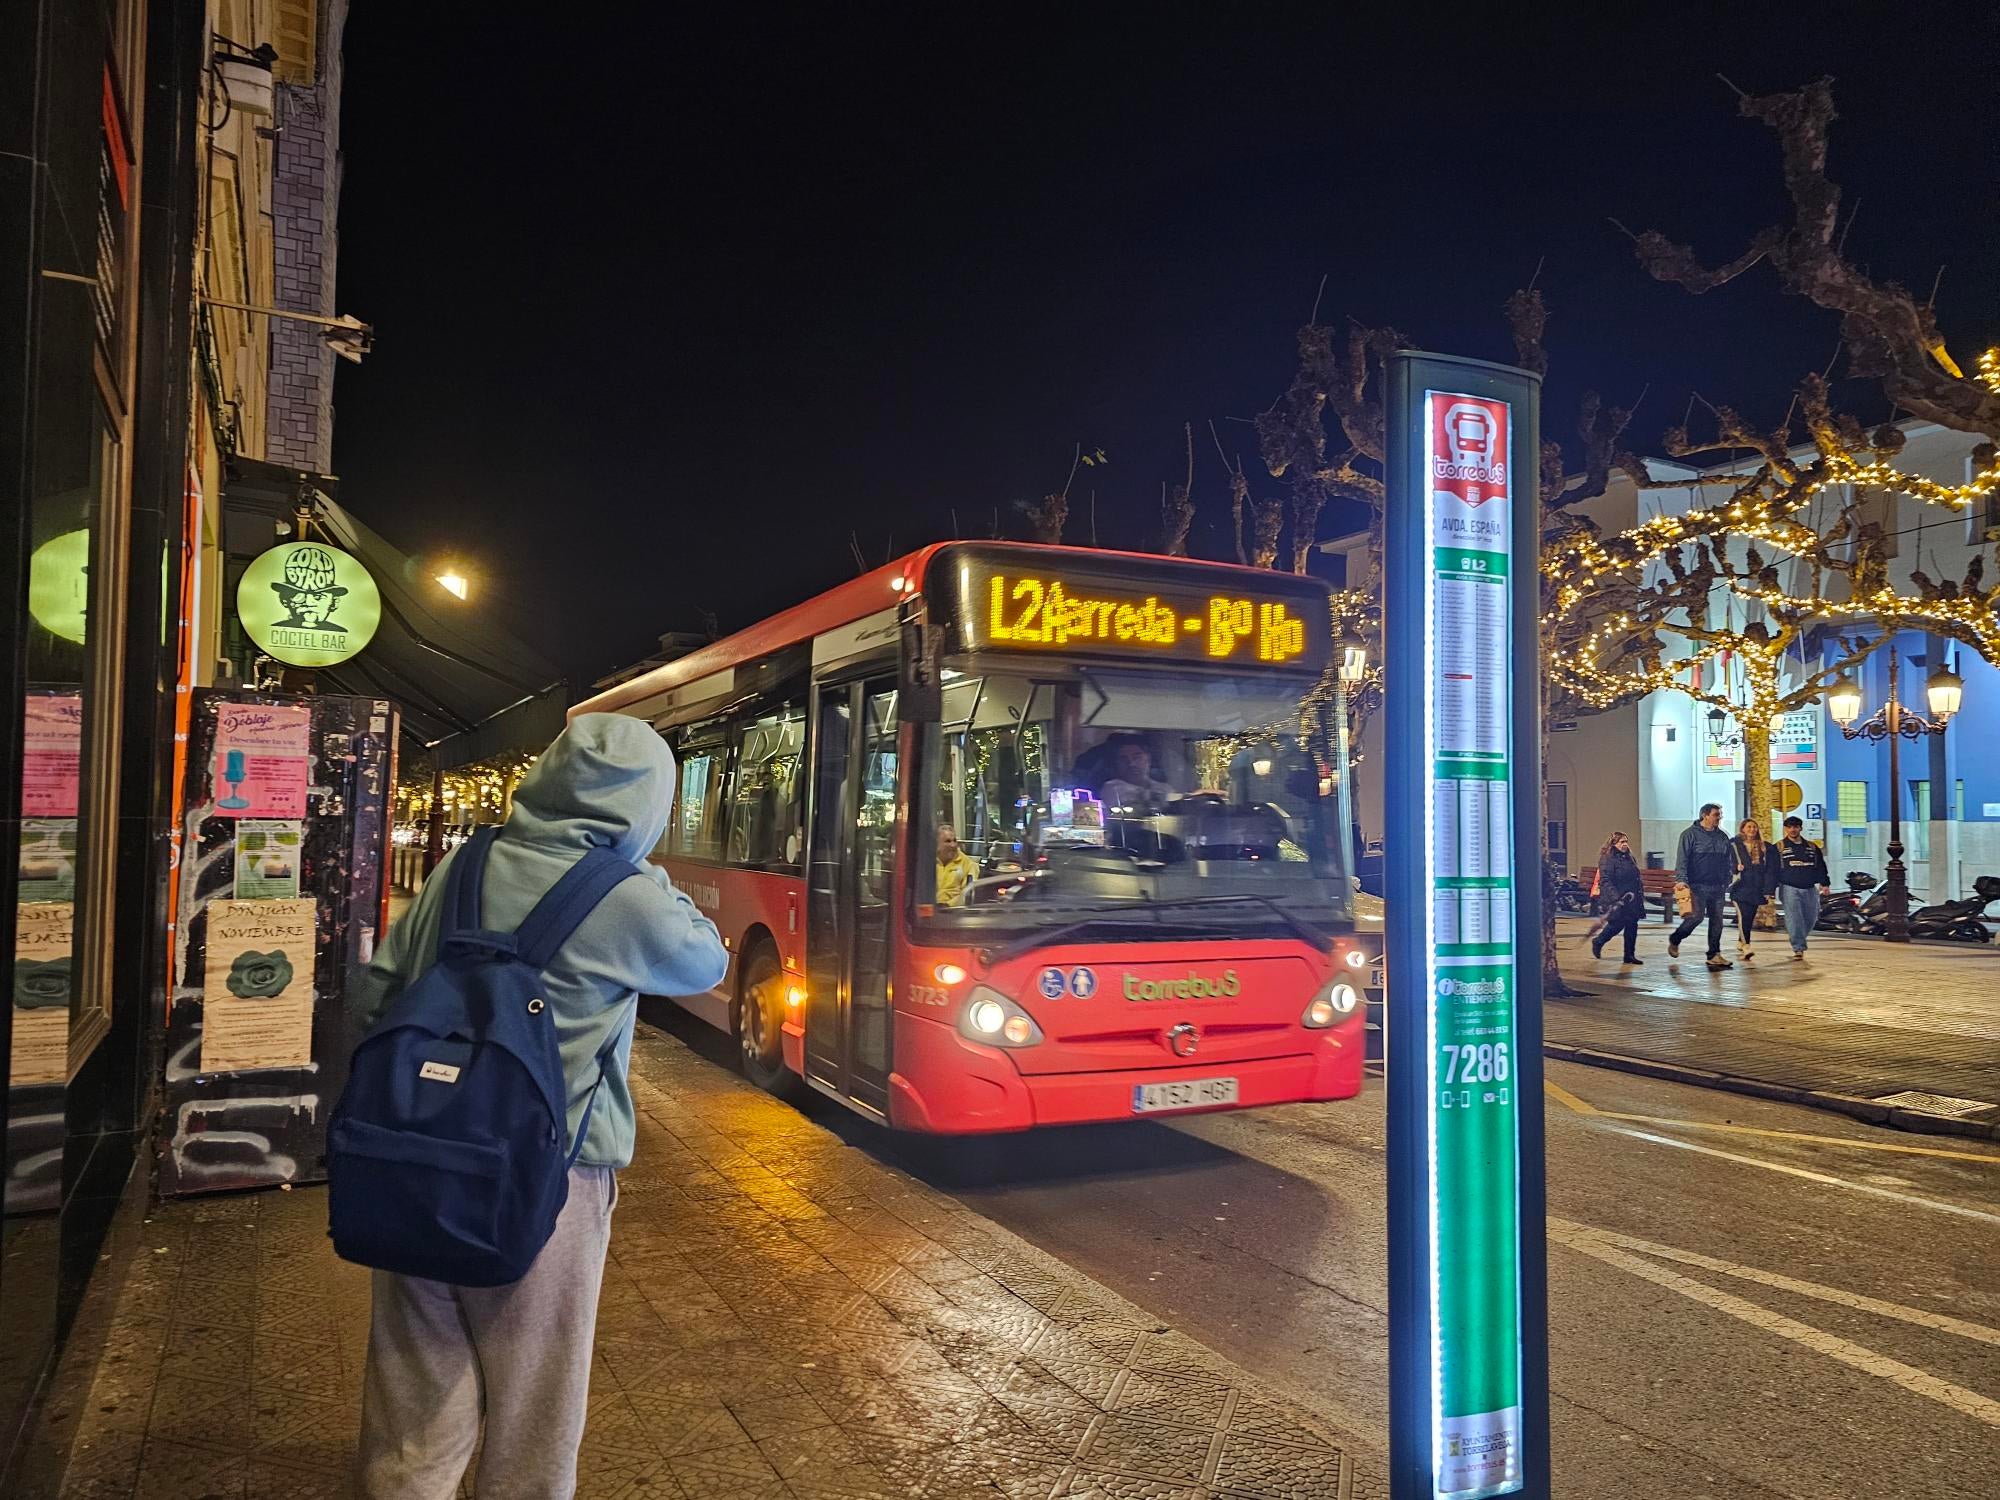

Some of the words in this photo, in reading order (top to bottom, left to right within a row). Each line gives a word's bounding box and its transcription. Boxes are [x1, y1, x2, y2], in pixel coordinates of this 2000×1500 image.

[1442, 518, 1468, 532] AVDA.
[1470, 520, 1501, 536] ESPAÑA
[286, 548, 334, 571] LORD
[1472, 559, 1487, 571] L2
[285, 567, 335, 590] BYRON
[270, 628, 317, 647] CÓCTEL
[321, 634, 346, 649] BAR
[1808, 804, 1820, 819] P
[219, 926, 305, 939] NOVIEMBRE
[908, 983, 950, 1007] 3723
[1441, 1042, 1509, 1084] 7286
